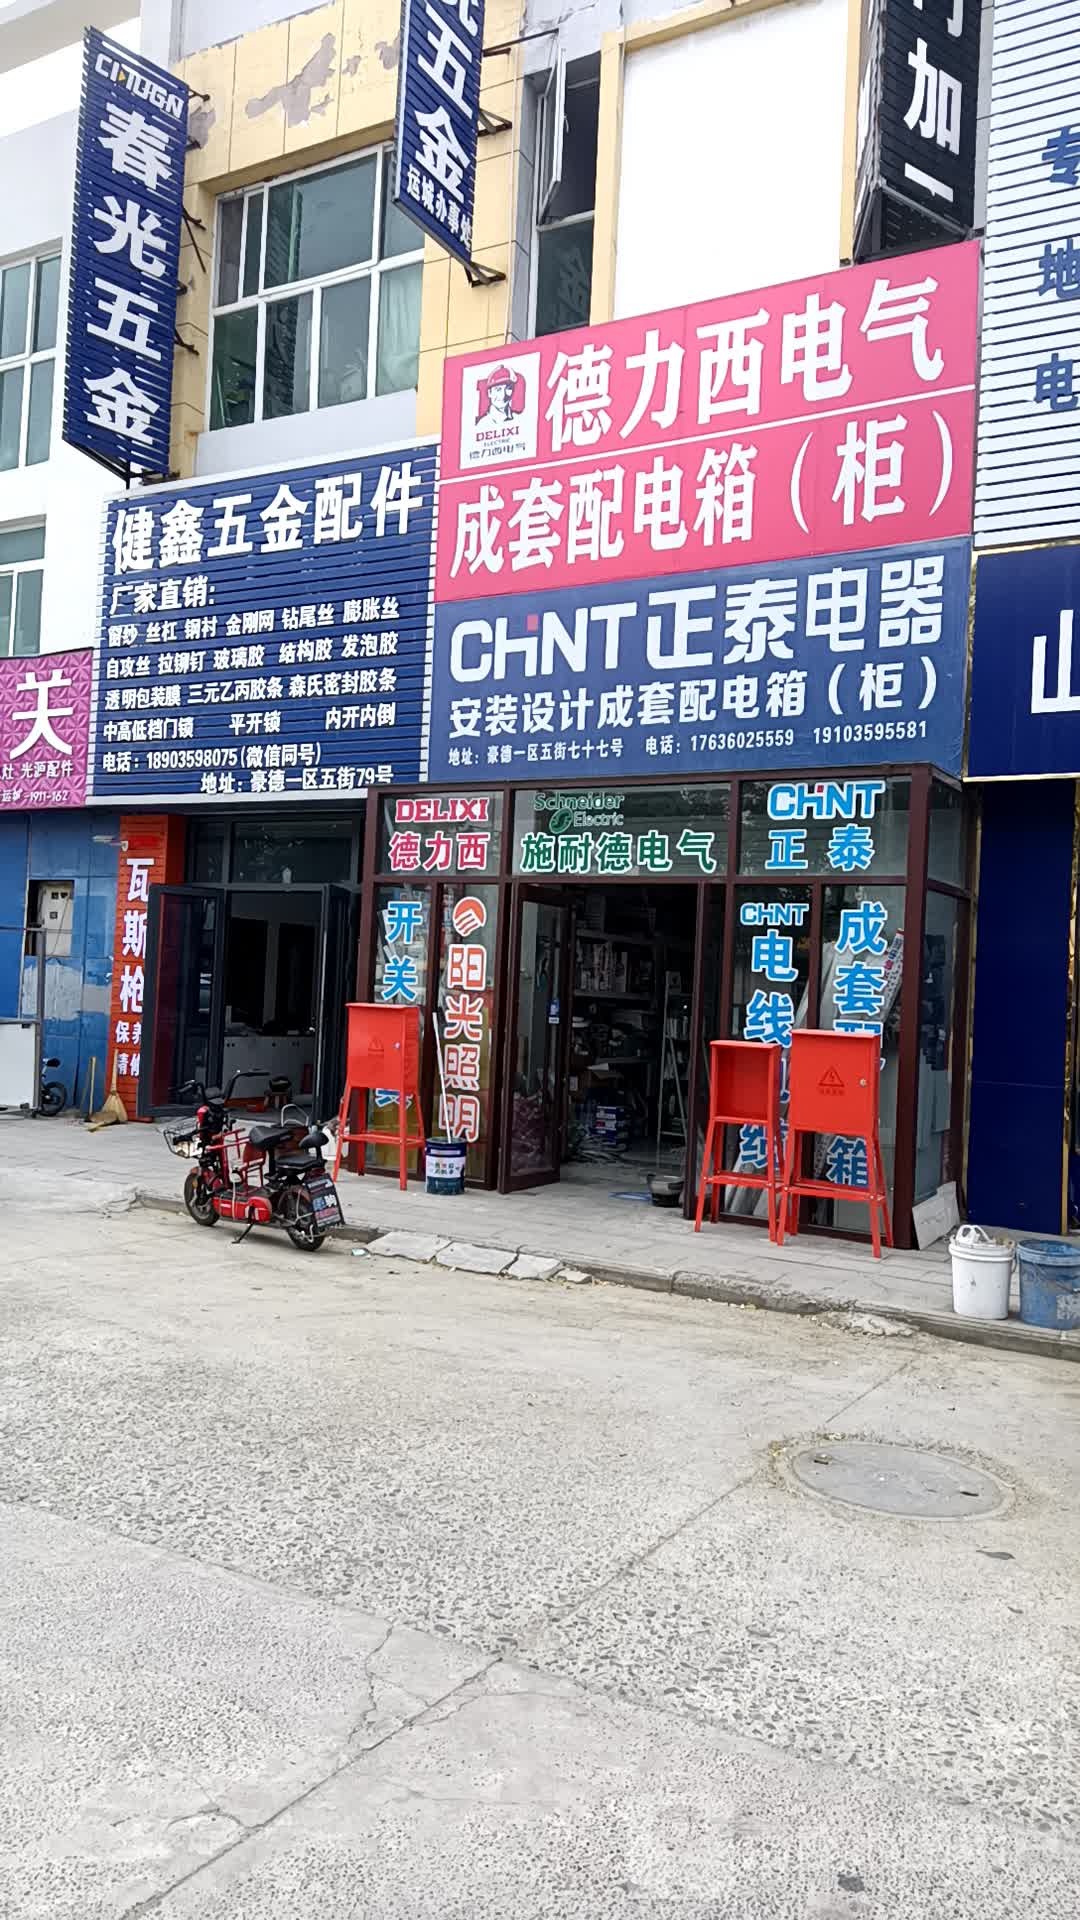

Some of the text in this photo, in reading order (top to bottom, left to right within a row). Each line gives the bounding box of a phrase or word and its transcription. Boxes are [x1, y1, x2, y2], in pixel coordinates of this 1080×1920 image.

[417, 0, 478, 203] 五金
[904, 0, 963, 203] 加一
[86, 102, 173, 446] 春光五金
[544, 278, 945, 453] 德力西电气
[476, 426, 520, 442] DELIXI
[111, 461, 423, 575] 健鑫五金配件
[449, 410, 953, 579] 成套配电箱（柜）
[226, 609, 275, 637] 金刚网
[282, 603, 335, 630] 钻尾丝
[342, 596, 400, 623] 膨胀丝
[106, 655, 150, 679] 自攻丝
[213, 645, 265, 670] 玻璃胶
[278, 638, 333, 664] 结构胶
[341, 631, 399, 658] 发泡胶
[104, 667, 397, 710] 透明包装膜 三元乙丙胶条 森氏密封胶条
[449, 656, 937, 739] 安装设计成套配电箱（柜）
[103, 702, 396, 742] 中高低档门锁 平开锁 内开内倒
[813, 720, 928, 745] 19103595581
[395, 797, 490, 823] DELIXI
[534, 791, 625, 811] Schneider
[573, 811, 625, 828] Electric
[388, 830, 491, 871] 德力西
[520, 828, 717, 874] 施耐德电气
[765, 824, 875, 872] 正泰
[119, 858, 155, 1013] 瓦斯枪
[740, 902, 809, 927] CHNT
[438, 944, 487, 1143] 阳光照明
